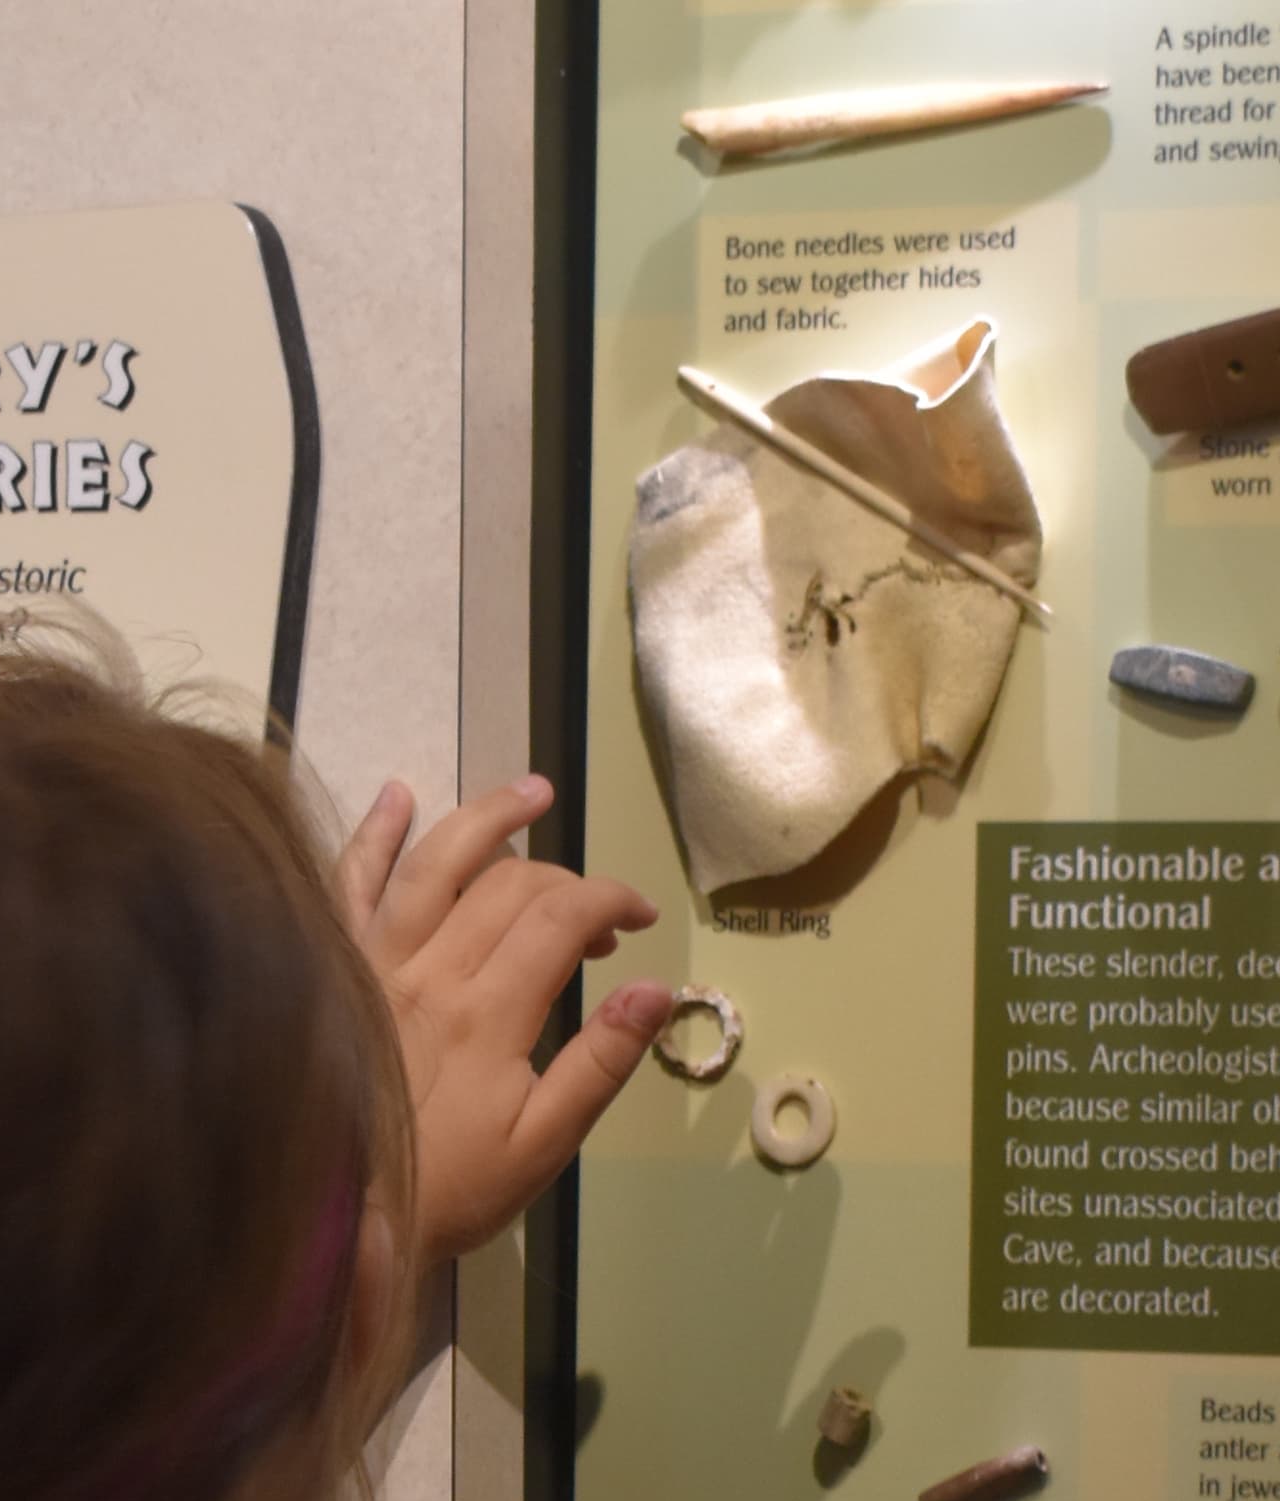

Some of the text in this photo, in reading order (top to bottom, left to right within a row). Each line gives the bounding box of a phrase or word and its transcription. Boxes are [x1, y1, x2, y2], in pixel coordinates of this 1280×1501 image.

[1155, 26, 1172, 50] A
[1183, 22, 1270, 54] spindle
[1155, 66, 1212, 88] have
[1222, 62, 1280, 85] been
[1155, 100, 1232, 125] thread
[1243, 97, 1275, 122] for
[1154, 139, 1199, 164] and
[726, 228, 1016, 261] Bone needles were used
[724, 265, 981, 297] to sew together hides
[724, 306, 849, 332] and fabric.
[1200, 435, 1271, 460] Stone
[1211, 477, 1271, 496] worn
[1009, 845, 1245, 882] Fashionable
[712, 909, 831, 940] Shell Ring
[1008, 894, 1211, 930] Functional
[1008, 947, 1096, 978] These
[1106, 950, 1224, 981] slender,
[1007, 1002, 1077, 1026] were
[1088, 997, 1219, 1032] probably
[1006, 1044, 1077, 1077] pins.
[1006, 1092, 1128, 1122] because
[1140, 1093, 1243, 1125] similar
[1005, 1139, 1088, 1169] found
[1101, 1143, 1217, 1172] crossed
[1003, 1188, 1072, 1216] sites
[1003, 1234, 1083, 1267] Cave,
[1095, 1237, 1151, 1266] and
[1002, 1284, 1219, 1317] are decorated.
[1201, 1398, 1275, 1424] Beads
[1200, 1437, 1269, 1461] antler
[1199, 1473, 1220, 1497] in
